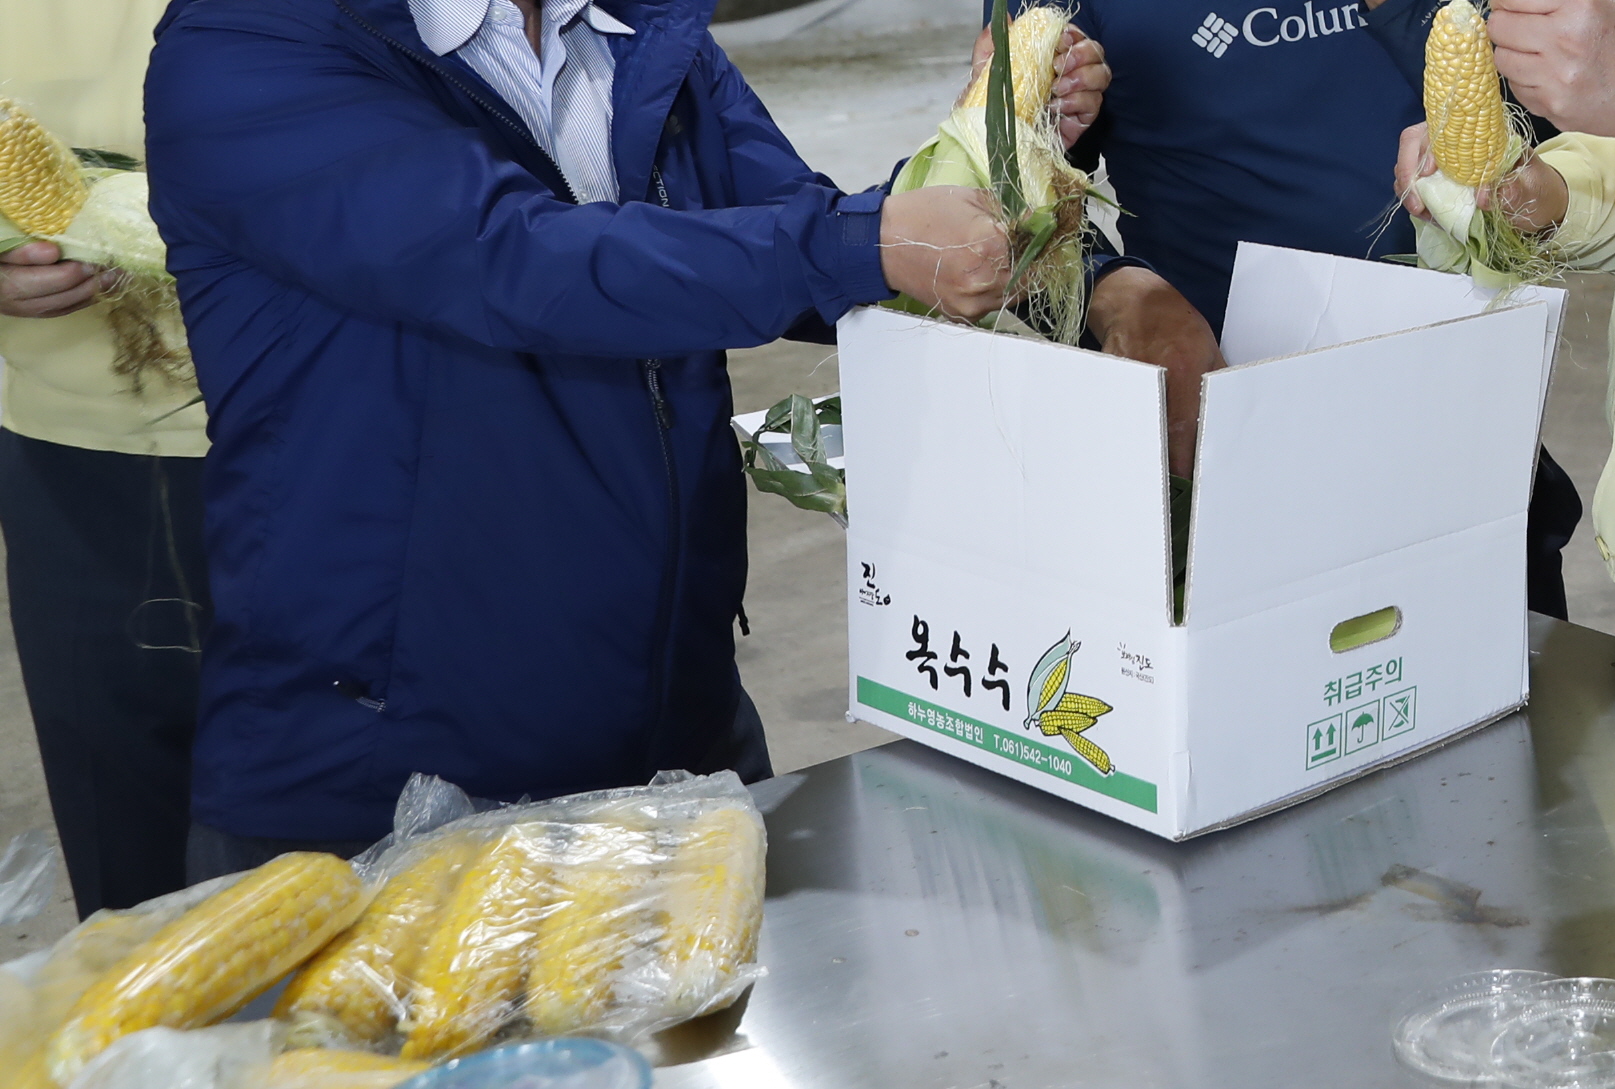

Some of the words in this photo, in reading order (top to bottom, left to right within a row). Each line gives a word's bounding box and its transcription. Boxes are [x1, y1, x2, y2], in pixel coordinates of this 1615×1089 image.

[906, 614, 1010, 711] 옥수수
[1323, 656, 1403, 707] 취급주의
[908, 701, 984, 744] 하누영농조합법인
[993, 734, 1072, 776] T.061)542-1040
